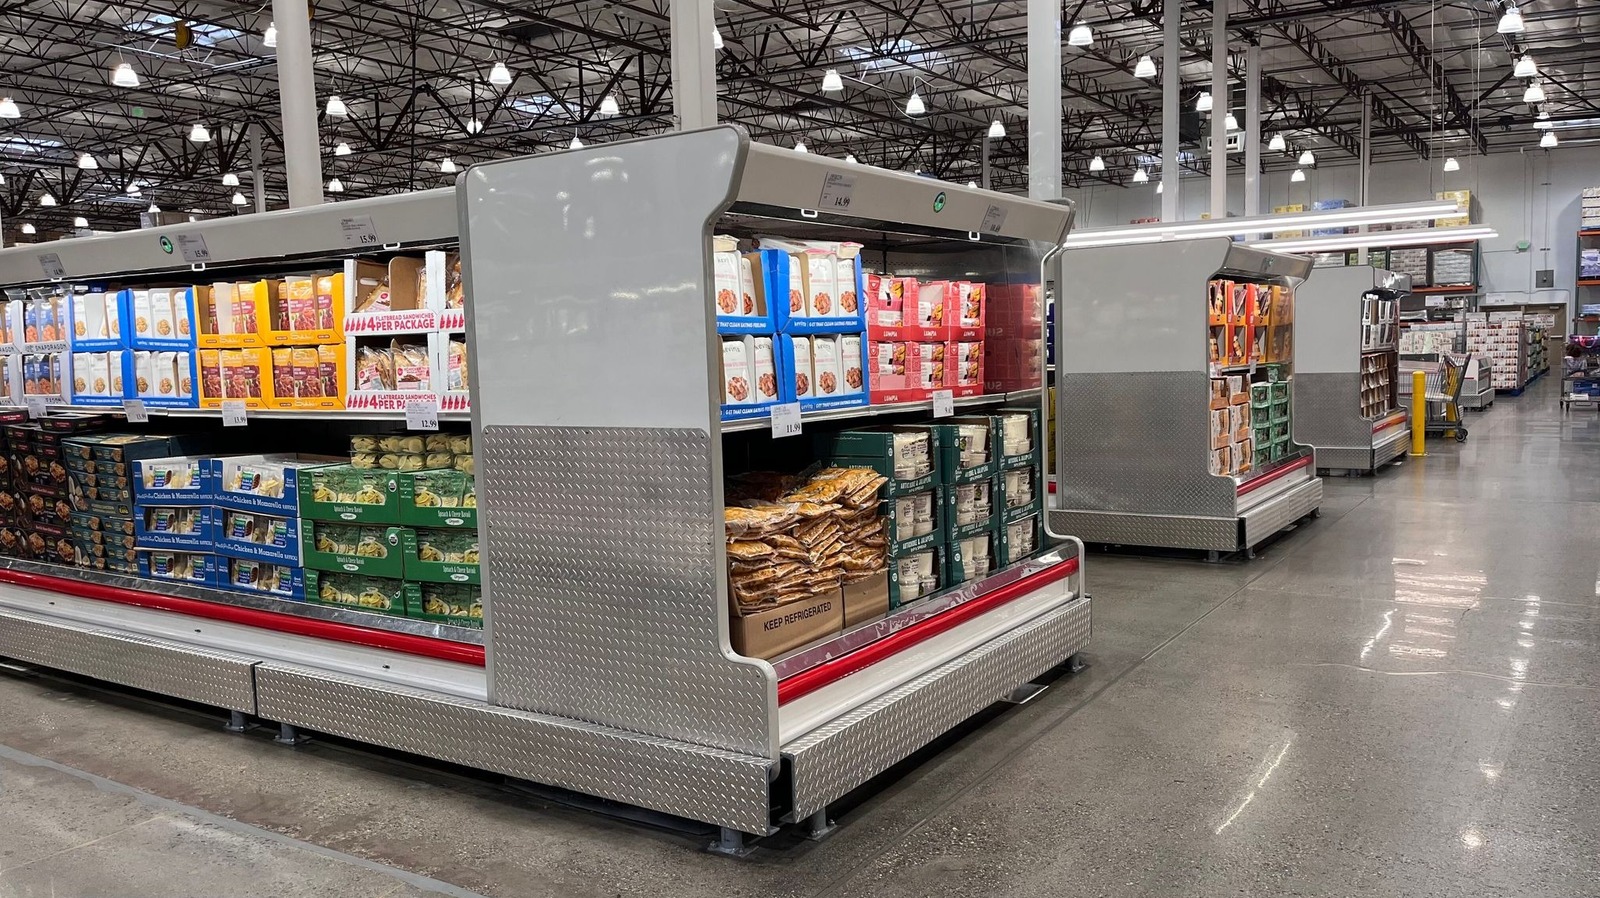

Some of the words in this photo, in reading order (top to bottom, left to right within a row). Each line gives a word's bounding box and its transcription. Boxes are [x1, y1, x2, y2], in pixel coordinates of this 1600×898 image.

[834, 197, 850, 207] 14.99
[359, 234, 376, 244] 15.99
[367, 316, 376, 331] 4
[376, 321, 393, 331] PER
[394, 319, 435, 330] PACKAGE
[370, 395, 378, 409] 4
[378, 400, 395, 410] PER
[787, 423, 800, 433] 11.99
[233, 496, 252, 505] Chicken
[234, 544, 253, 554] Chicken
[764, 618, 783, 631] KEEP
[785, 602, 832, 625] REFRIGERATED
